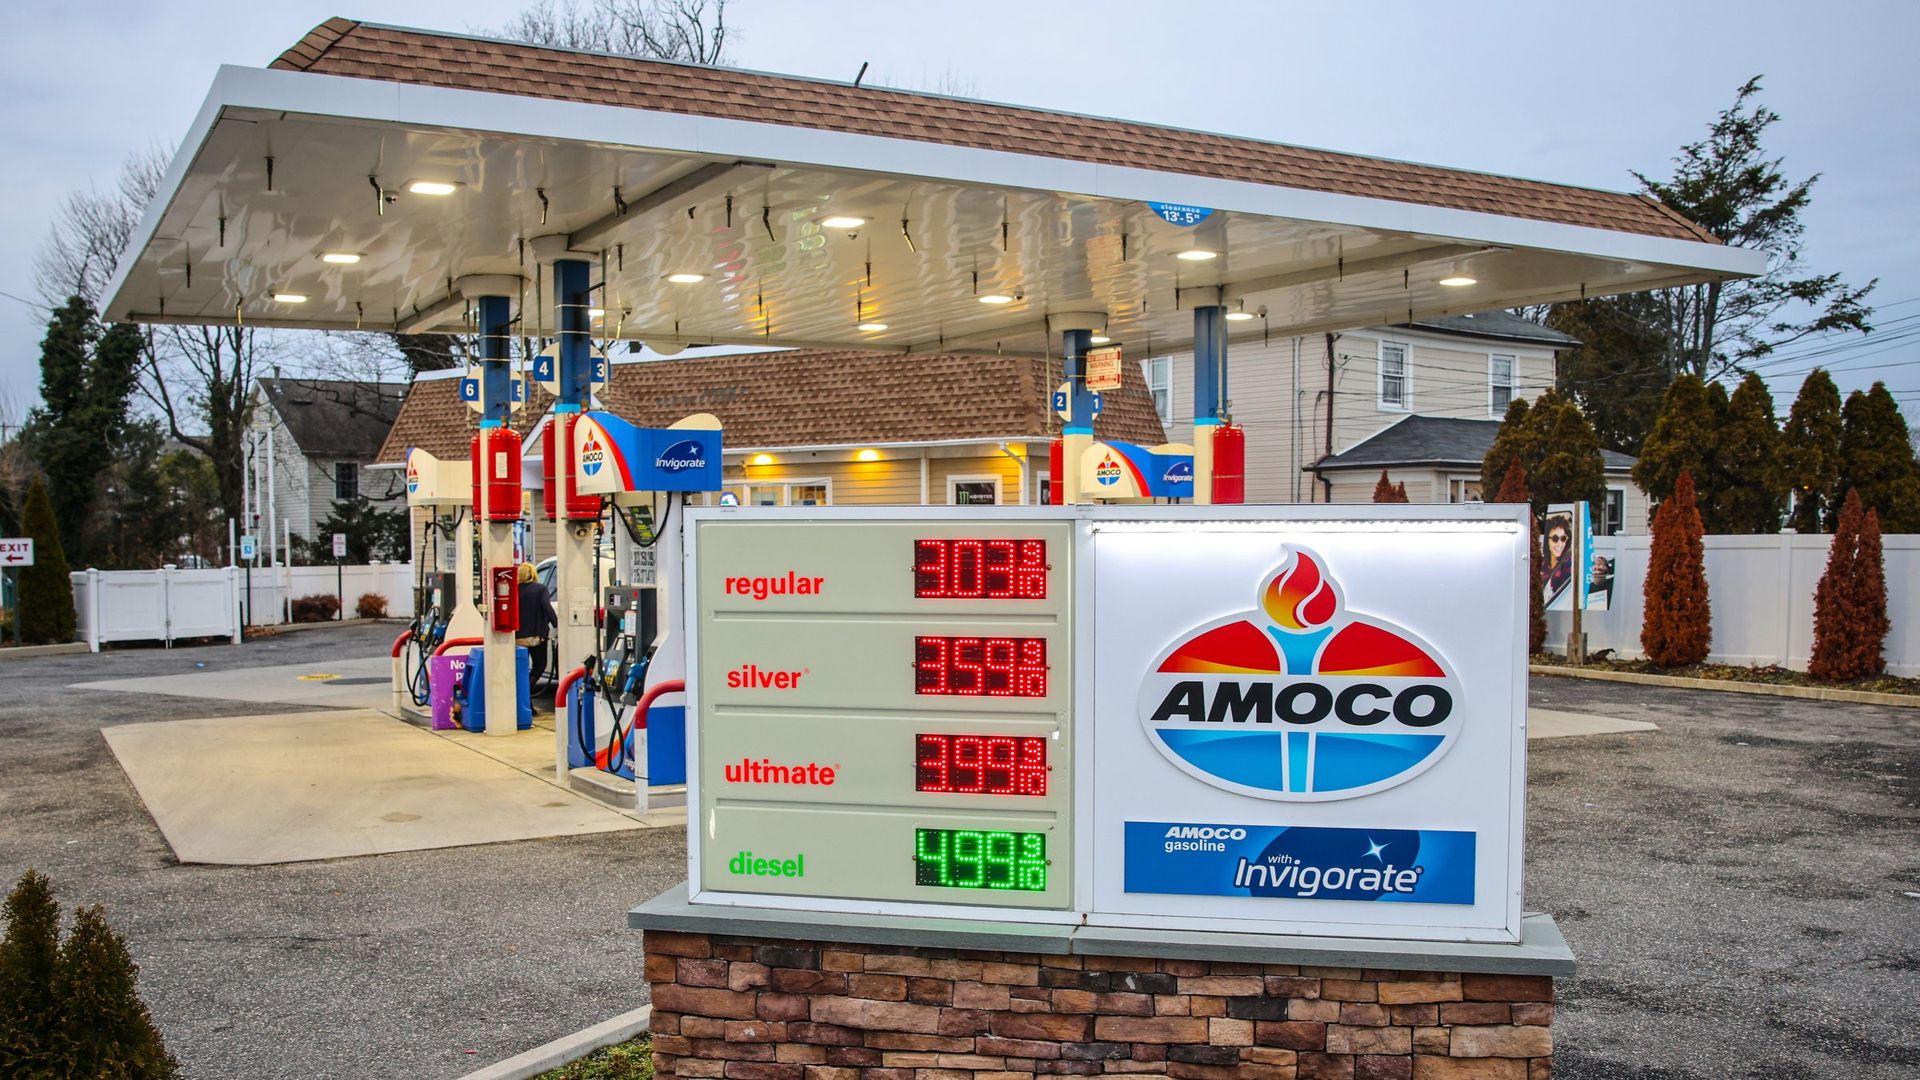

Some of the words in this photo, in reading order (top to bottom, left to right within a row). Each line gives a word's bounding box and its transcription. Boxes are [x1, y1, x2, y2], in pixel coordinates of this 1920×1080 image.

[1160, 204, 1201, 213] clearance
[539, 361, 549, 376] 4
[596, 363, 605, 378] 3
[465, 384, 475, 397] 6
[1056, 396, 1064, 407] 2
[1093, 398, 1099, 409] 1
[582, 451, 603, 462] AMOCO
[655, 458, 705, 470] Invigorate
[1163, 474, 1193, 483] Invigorate
[0, 543, 29, 552] EXIT
[920, 540, 1015, 597] 3.03
[725, 571, 824, 601] regular
[921, 638, 1015, 695] 3.59
[1150, 681, 1453, 728] AMOCO
[921, 736, 1015, 793] 3.99
[1164, 826, 1247, 841] AMOCO
[1164, 839, 1226, 853] gasoline
[729, 851, 804, 877] diesel
[918, 831, 1015, 887] 4.99
[1267, 853, 1292, 864] with
